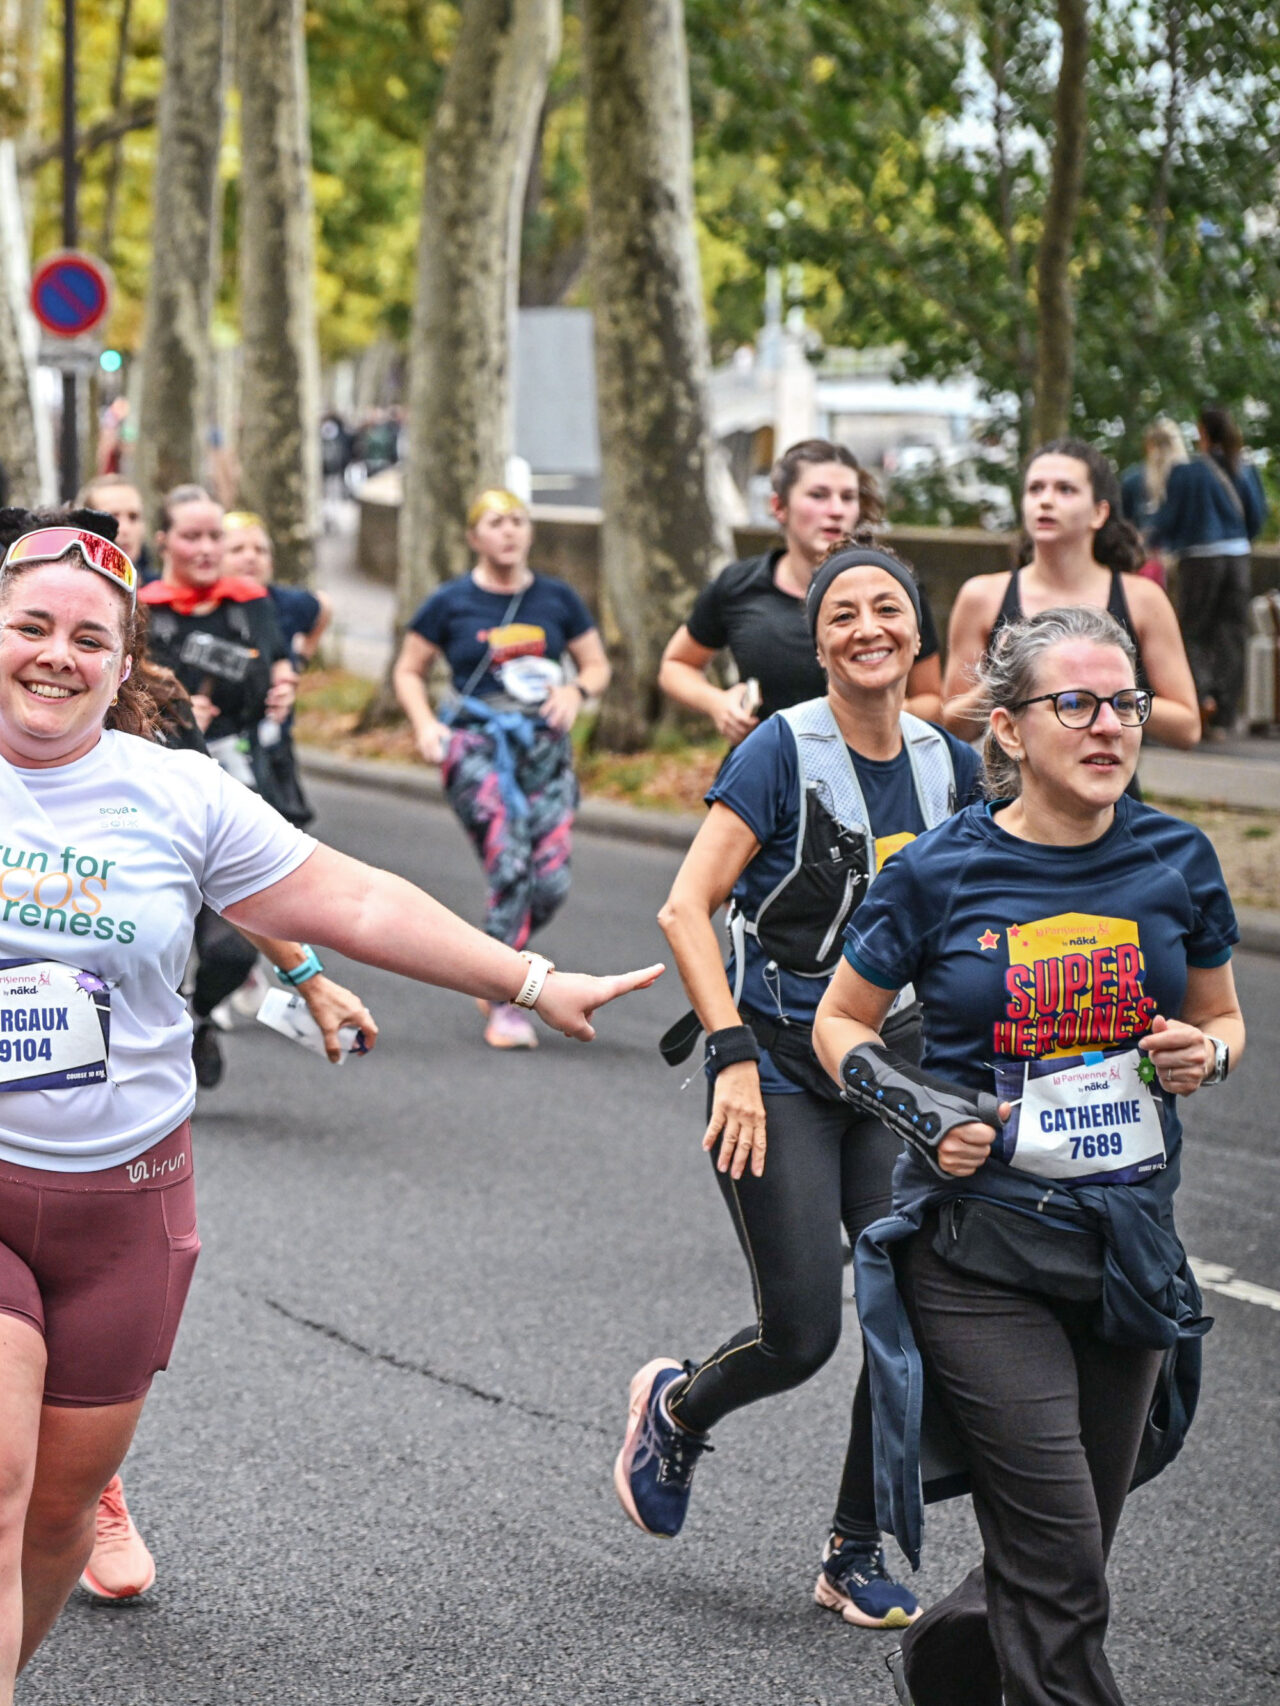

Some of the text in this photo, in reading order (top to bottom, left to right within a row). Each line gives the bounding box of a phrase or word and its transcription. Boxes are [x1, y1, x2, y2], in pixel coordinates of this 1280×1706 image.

[60, 846, 116, 880] for
[1004, 943, 1144, 1020] SUPER
[993, 996, 1157, 1058] HEROINES
[1039, 1099, 1141, 1133] CATHERINE
[1069, 1132, 1122, 1160] 7689
[152, 1152, 185, 1178] i-run
